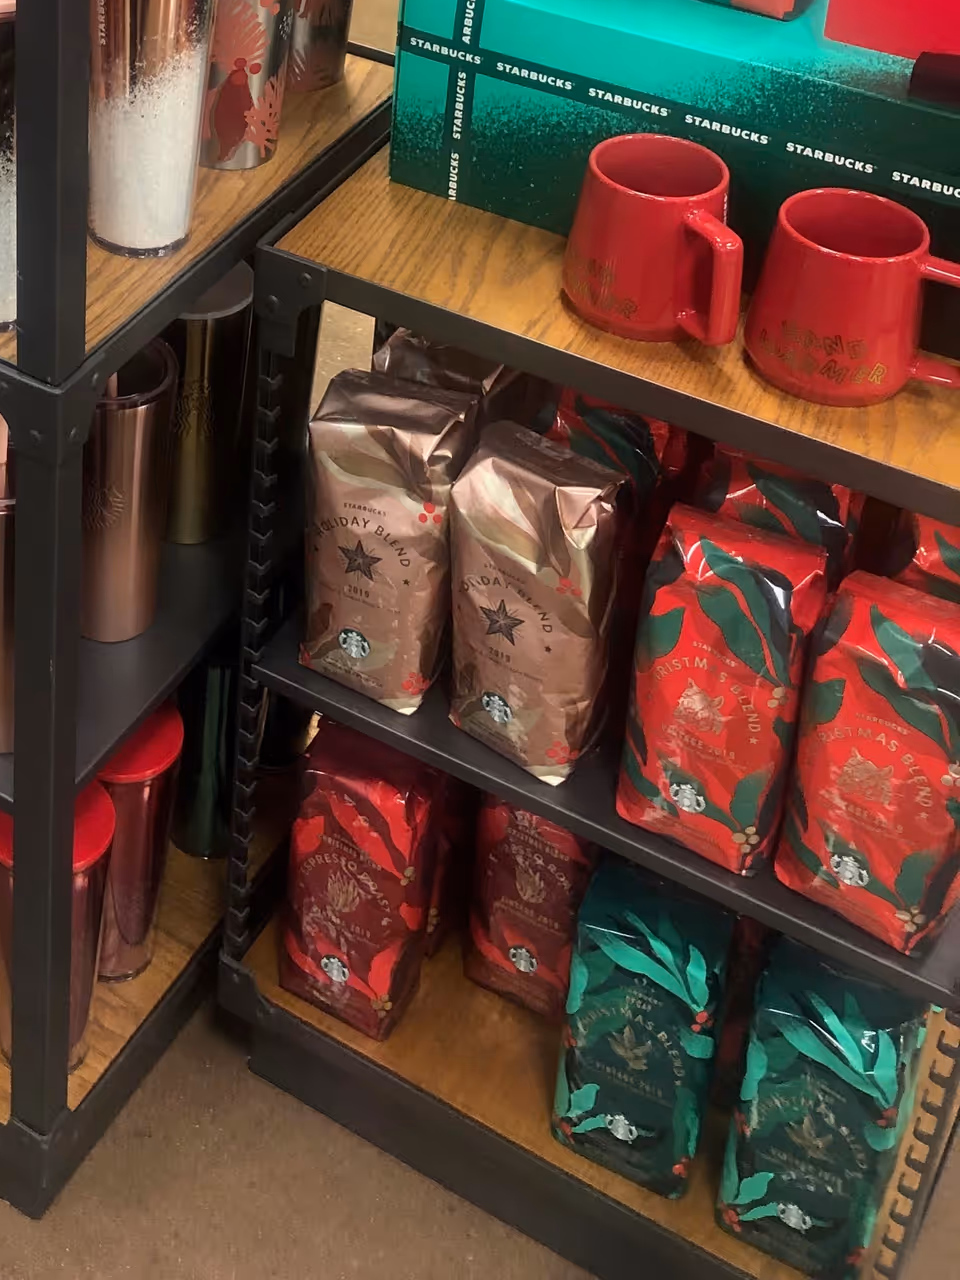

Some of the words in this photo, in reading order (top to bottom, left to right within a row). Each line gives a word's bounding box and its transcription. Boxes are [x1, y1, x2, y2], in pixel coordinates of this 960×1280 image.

[409, 36, 482, 65] STARBUCKS
[495, 62, 573, 91] STARBUCKS
[452, 71, 467, 140] STARBUCKS
[587, 87, 669, 118] STARBUCKS
[684, 114, 769, 146] STARBUCKS
[785, 141, 874, 174] STARBUCKS
[343, 502, 387, 517] STARBUCKS
[374, 524, 411, 568] BLEND
[347, 584, 371, 599] 2019
[729, 683, 762, 734] BLEND
[900, 752, 933, 809] BLEND
[656, 1030, 686, 1077] BLEND
